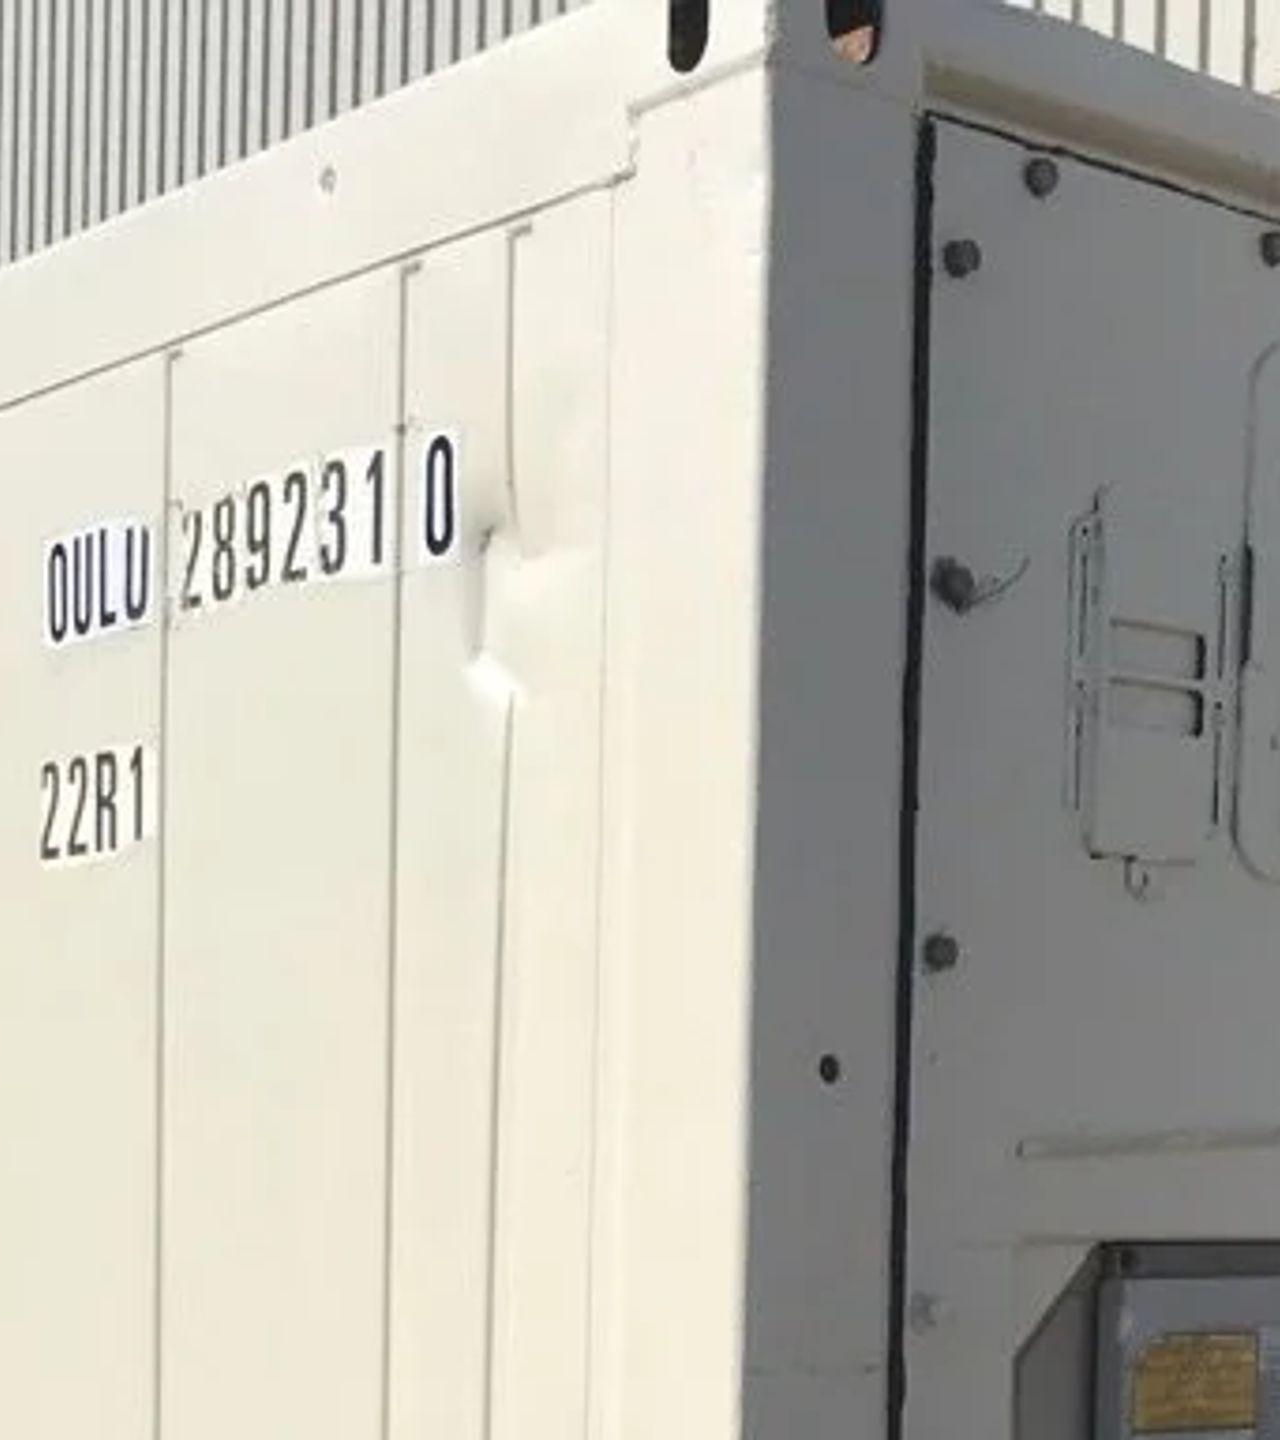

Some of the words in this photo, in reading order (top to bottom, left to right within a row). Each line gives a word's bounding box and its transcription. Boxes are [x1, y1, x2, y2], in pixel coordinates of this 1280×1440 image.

[47, 525, 151, 643] OULU
[180, 448, 385, 612] 289231
[424, 434, 455, 557] 0
[39, 744, 144, 860] 22R1
